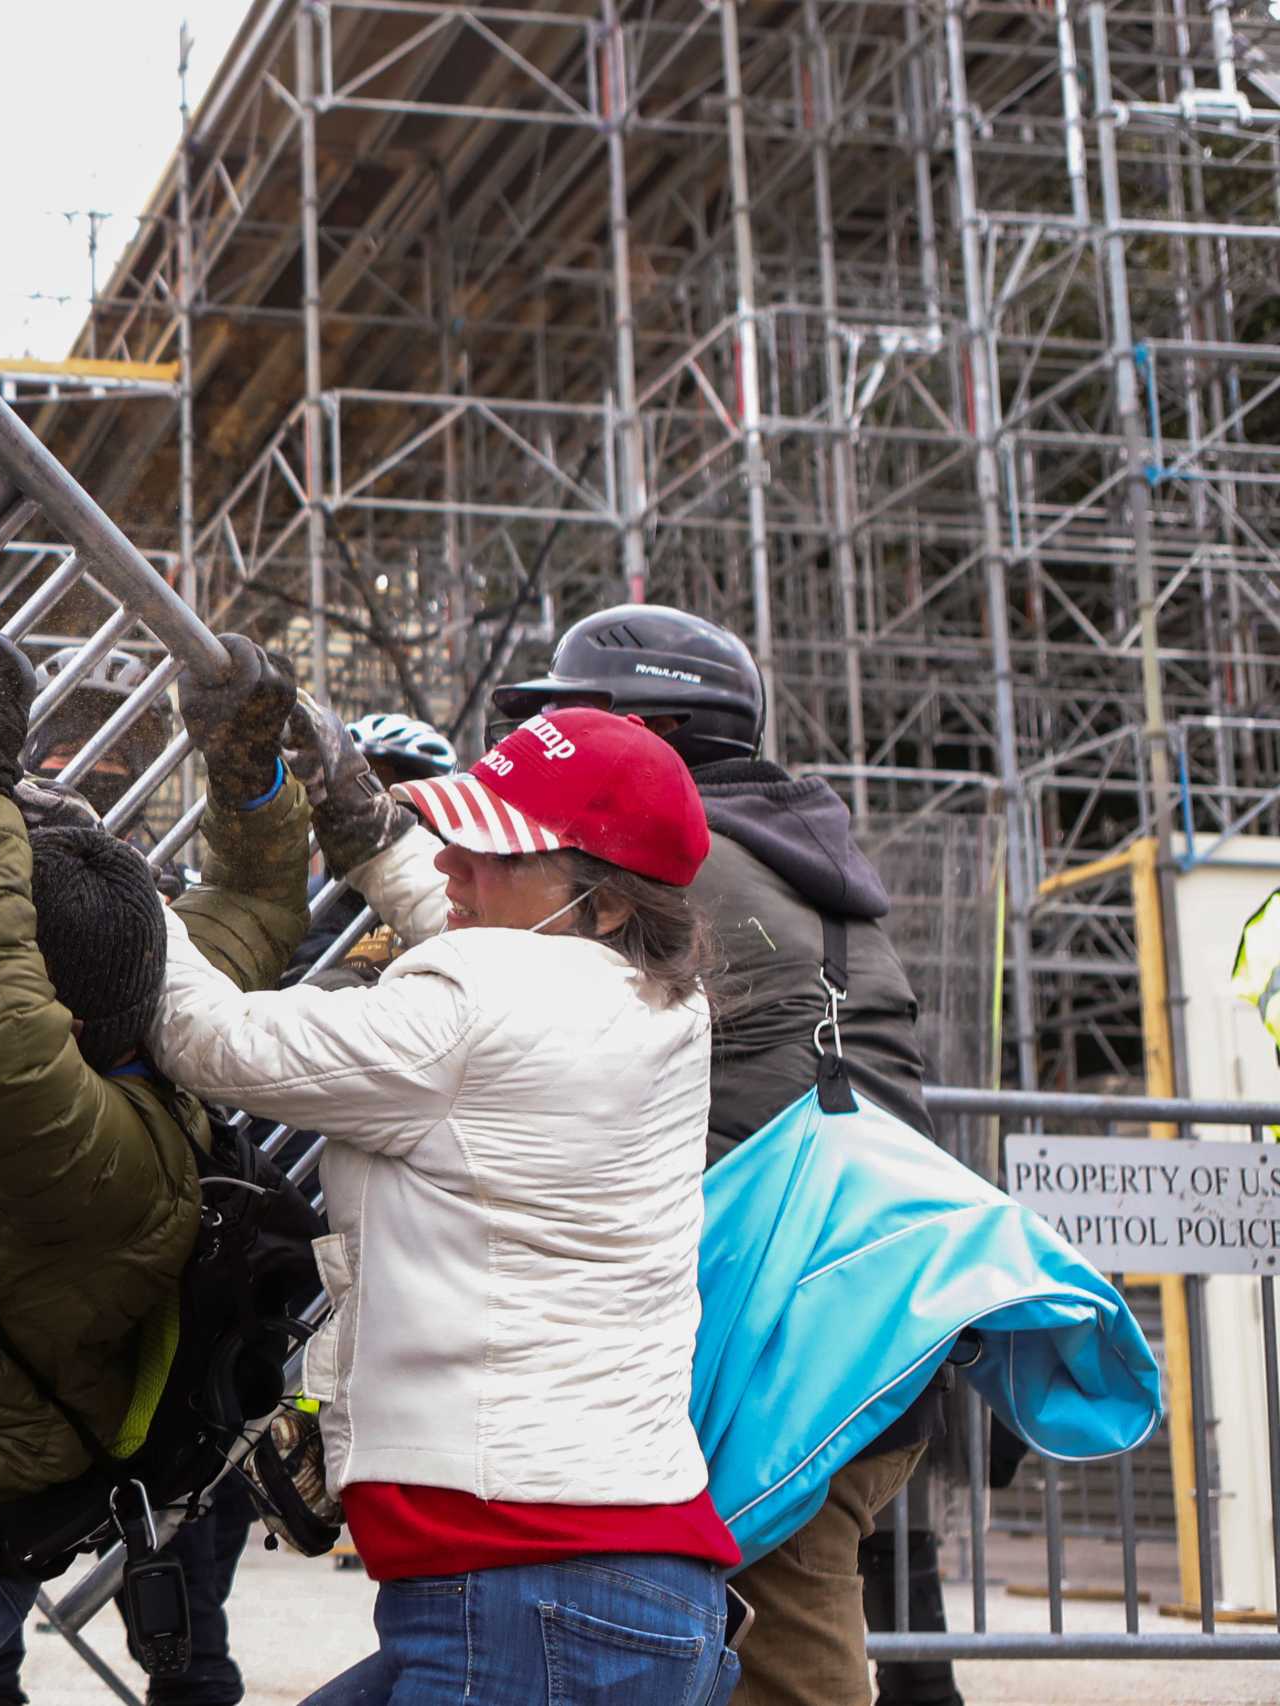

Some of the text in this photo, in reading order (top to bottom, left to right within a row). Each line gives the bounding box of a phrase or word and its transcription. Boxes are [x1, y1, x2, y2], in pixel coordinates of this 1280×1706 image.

[1014, 1162, 1180, 1196] PROPERTY
[1190, 1165, 1229, 1197] OF
[1039, 1214, 1168, 1247] APITOL
